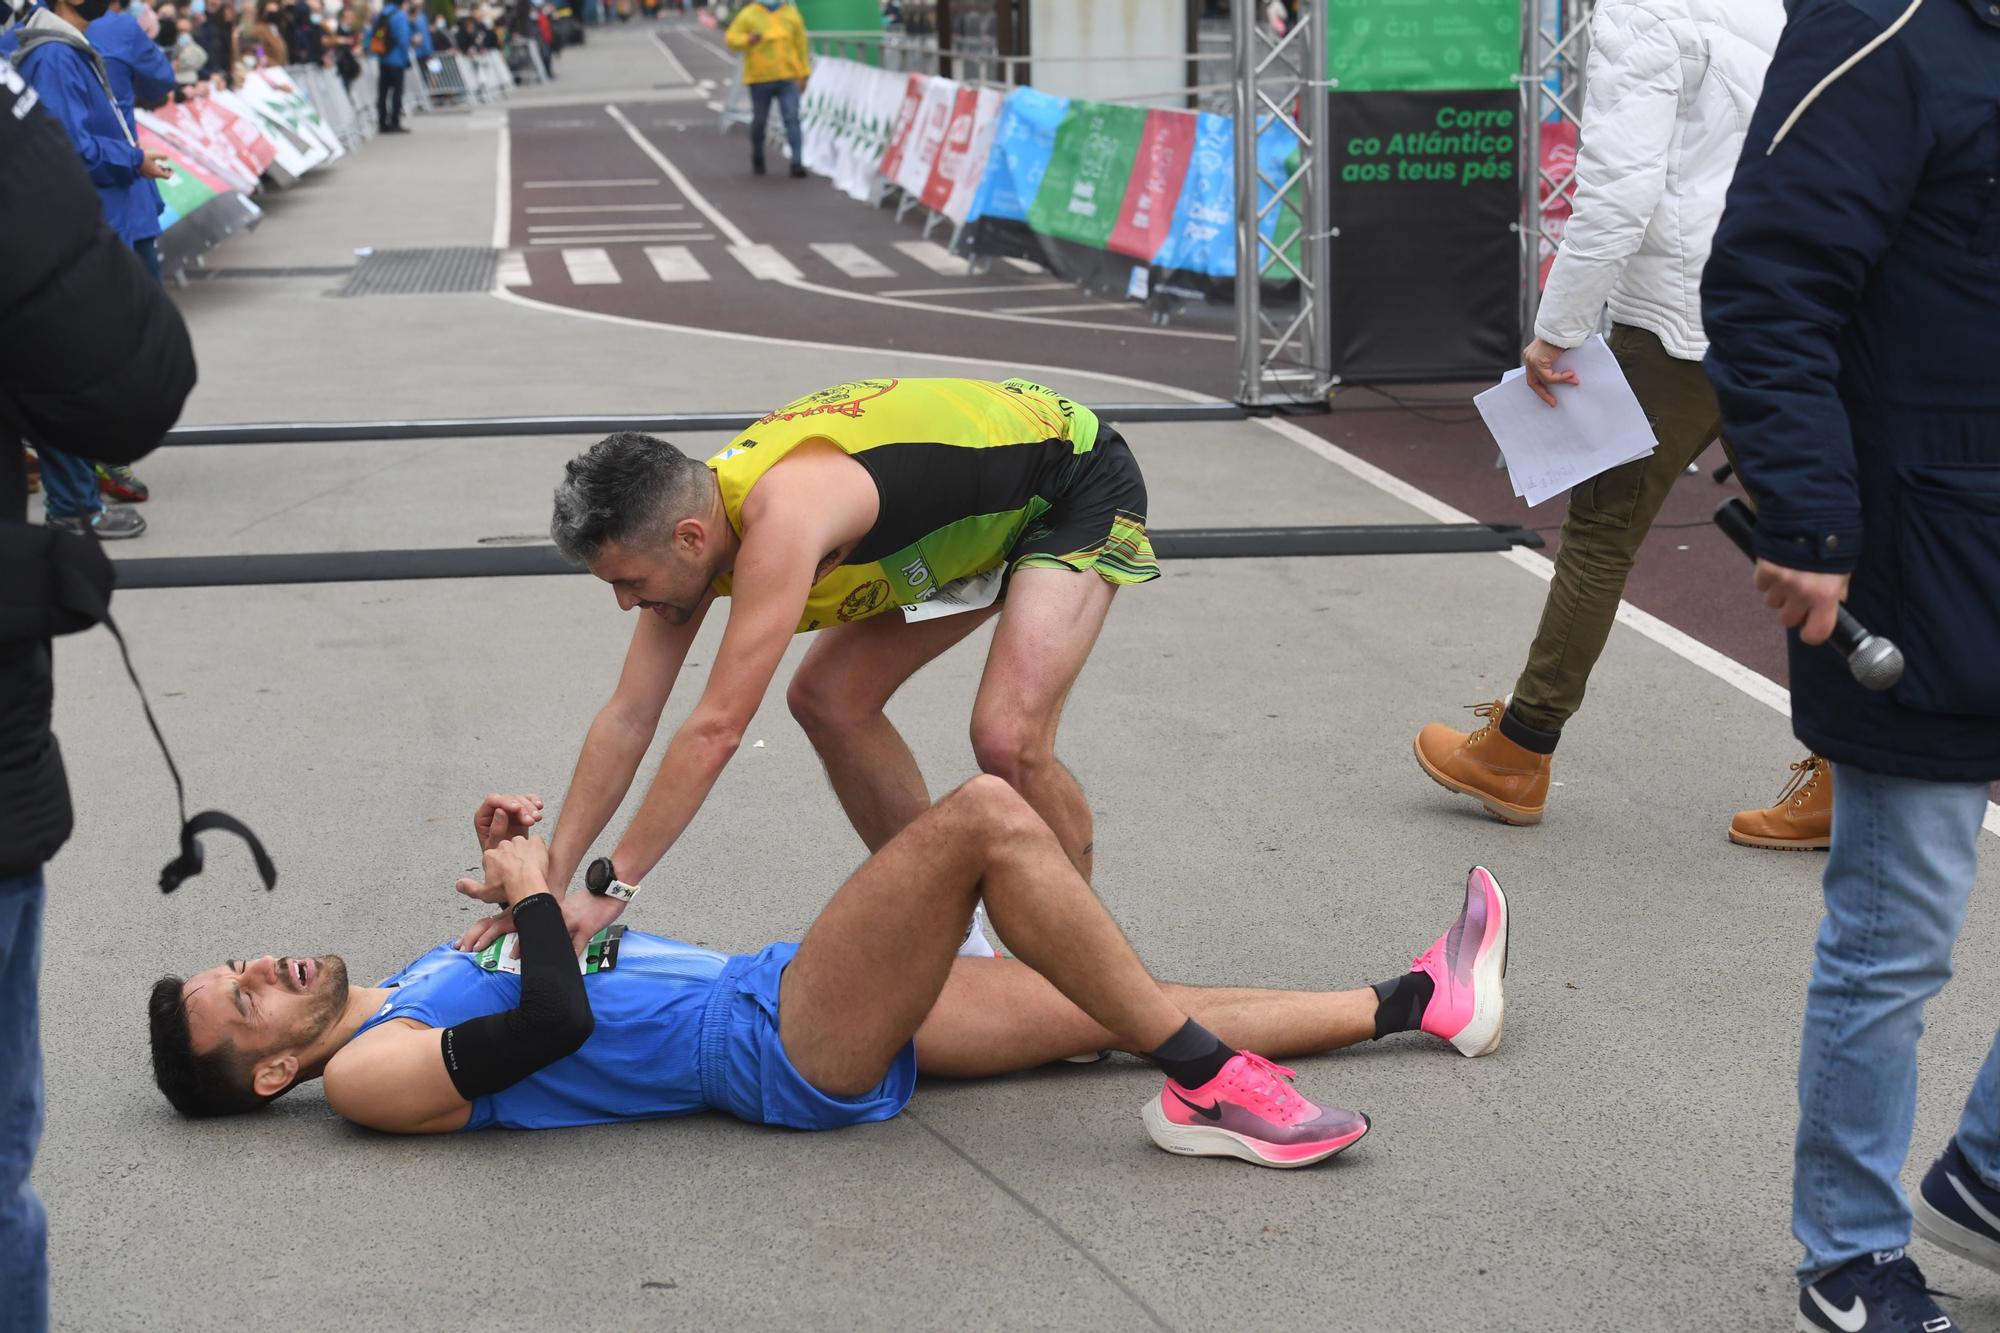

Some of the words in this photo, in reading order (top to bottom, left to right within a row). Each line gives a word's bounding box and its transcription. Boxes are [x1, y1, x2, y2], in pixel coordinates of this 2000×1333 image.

[1436, 107, 1513, 128] Corre
[1348, 138, 1381, 155] co
[1386, 131, 1513, 154] Atlántico
[1342, 163, 1390, 181] aos
[1398, 160, 1456, 180] teus
[1462, 156, 1512, 186] pés
